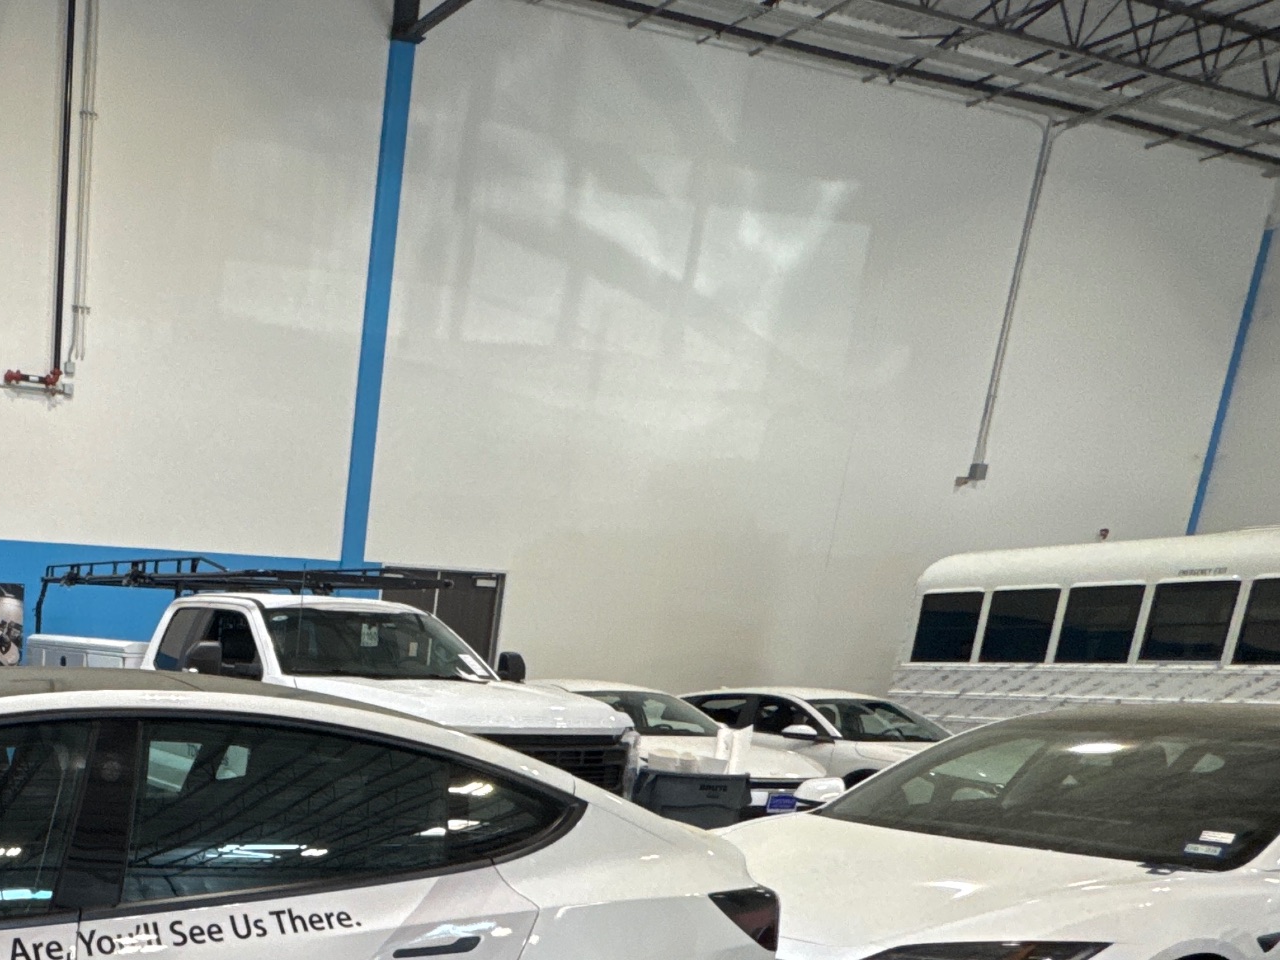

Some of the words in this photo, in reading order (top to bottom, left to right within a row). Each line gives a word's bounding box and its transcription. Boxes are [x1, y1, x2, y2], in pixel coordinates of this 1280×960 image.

[170, 920, 224, 946] See
[230, 914, 267, 939] Us
[269, 908, 362, 935] There.
